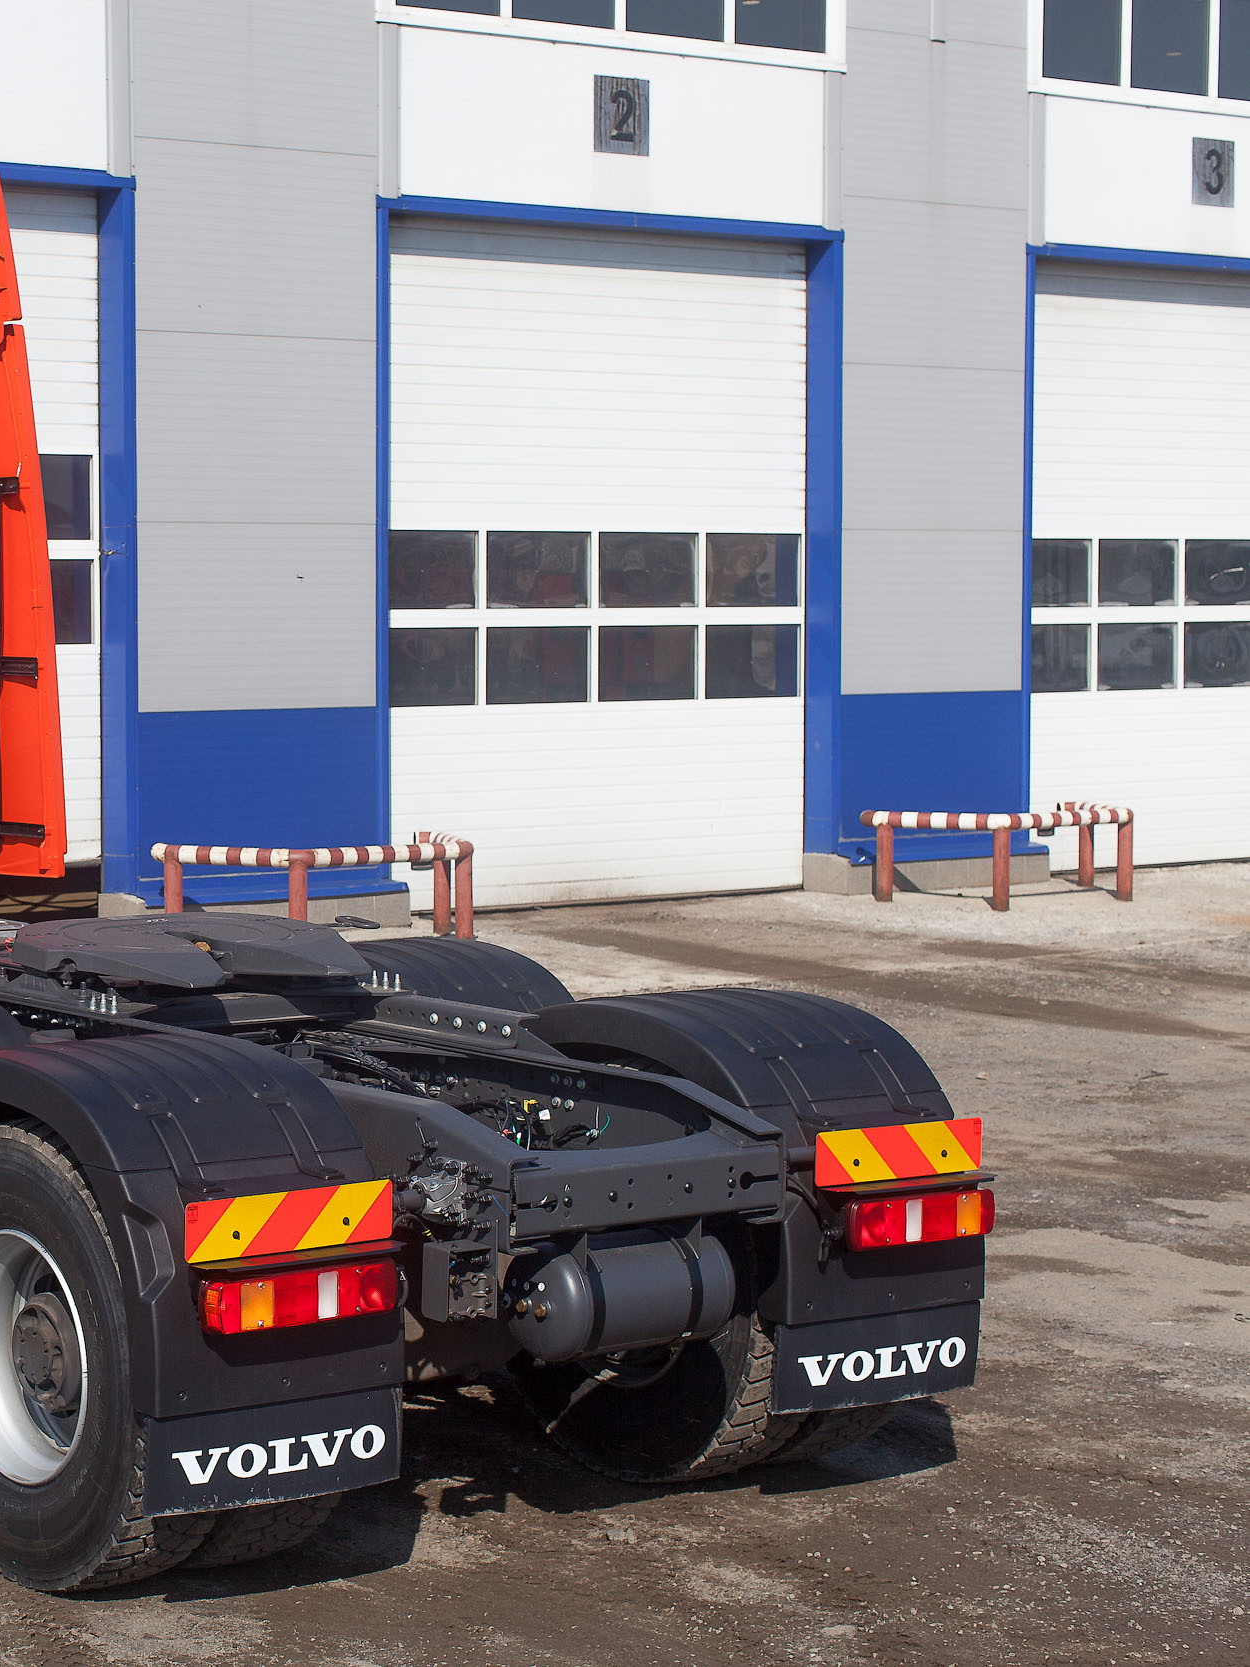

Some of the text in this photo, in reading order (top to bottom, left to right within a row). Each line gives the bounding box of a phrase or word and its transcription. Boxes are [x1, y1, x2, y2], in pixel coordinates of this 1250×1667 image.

[611, 90, 634, 142] 2
[1206, 149, 1223, 194] 3
[797, 1336, 966, 1387] VOLVO
[171, 1424, 386, 1485] VOLVO
